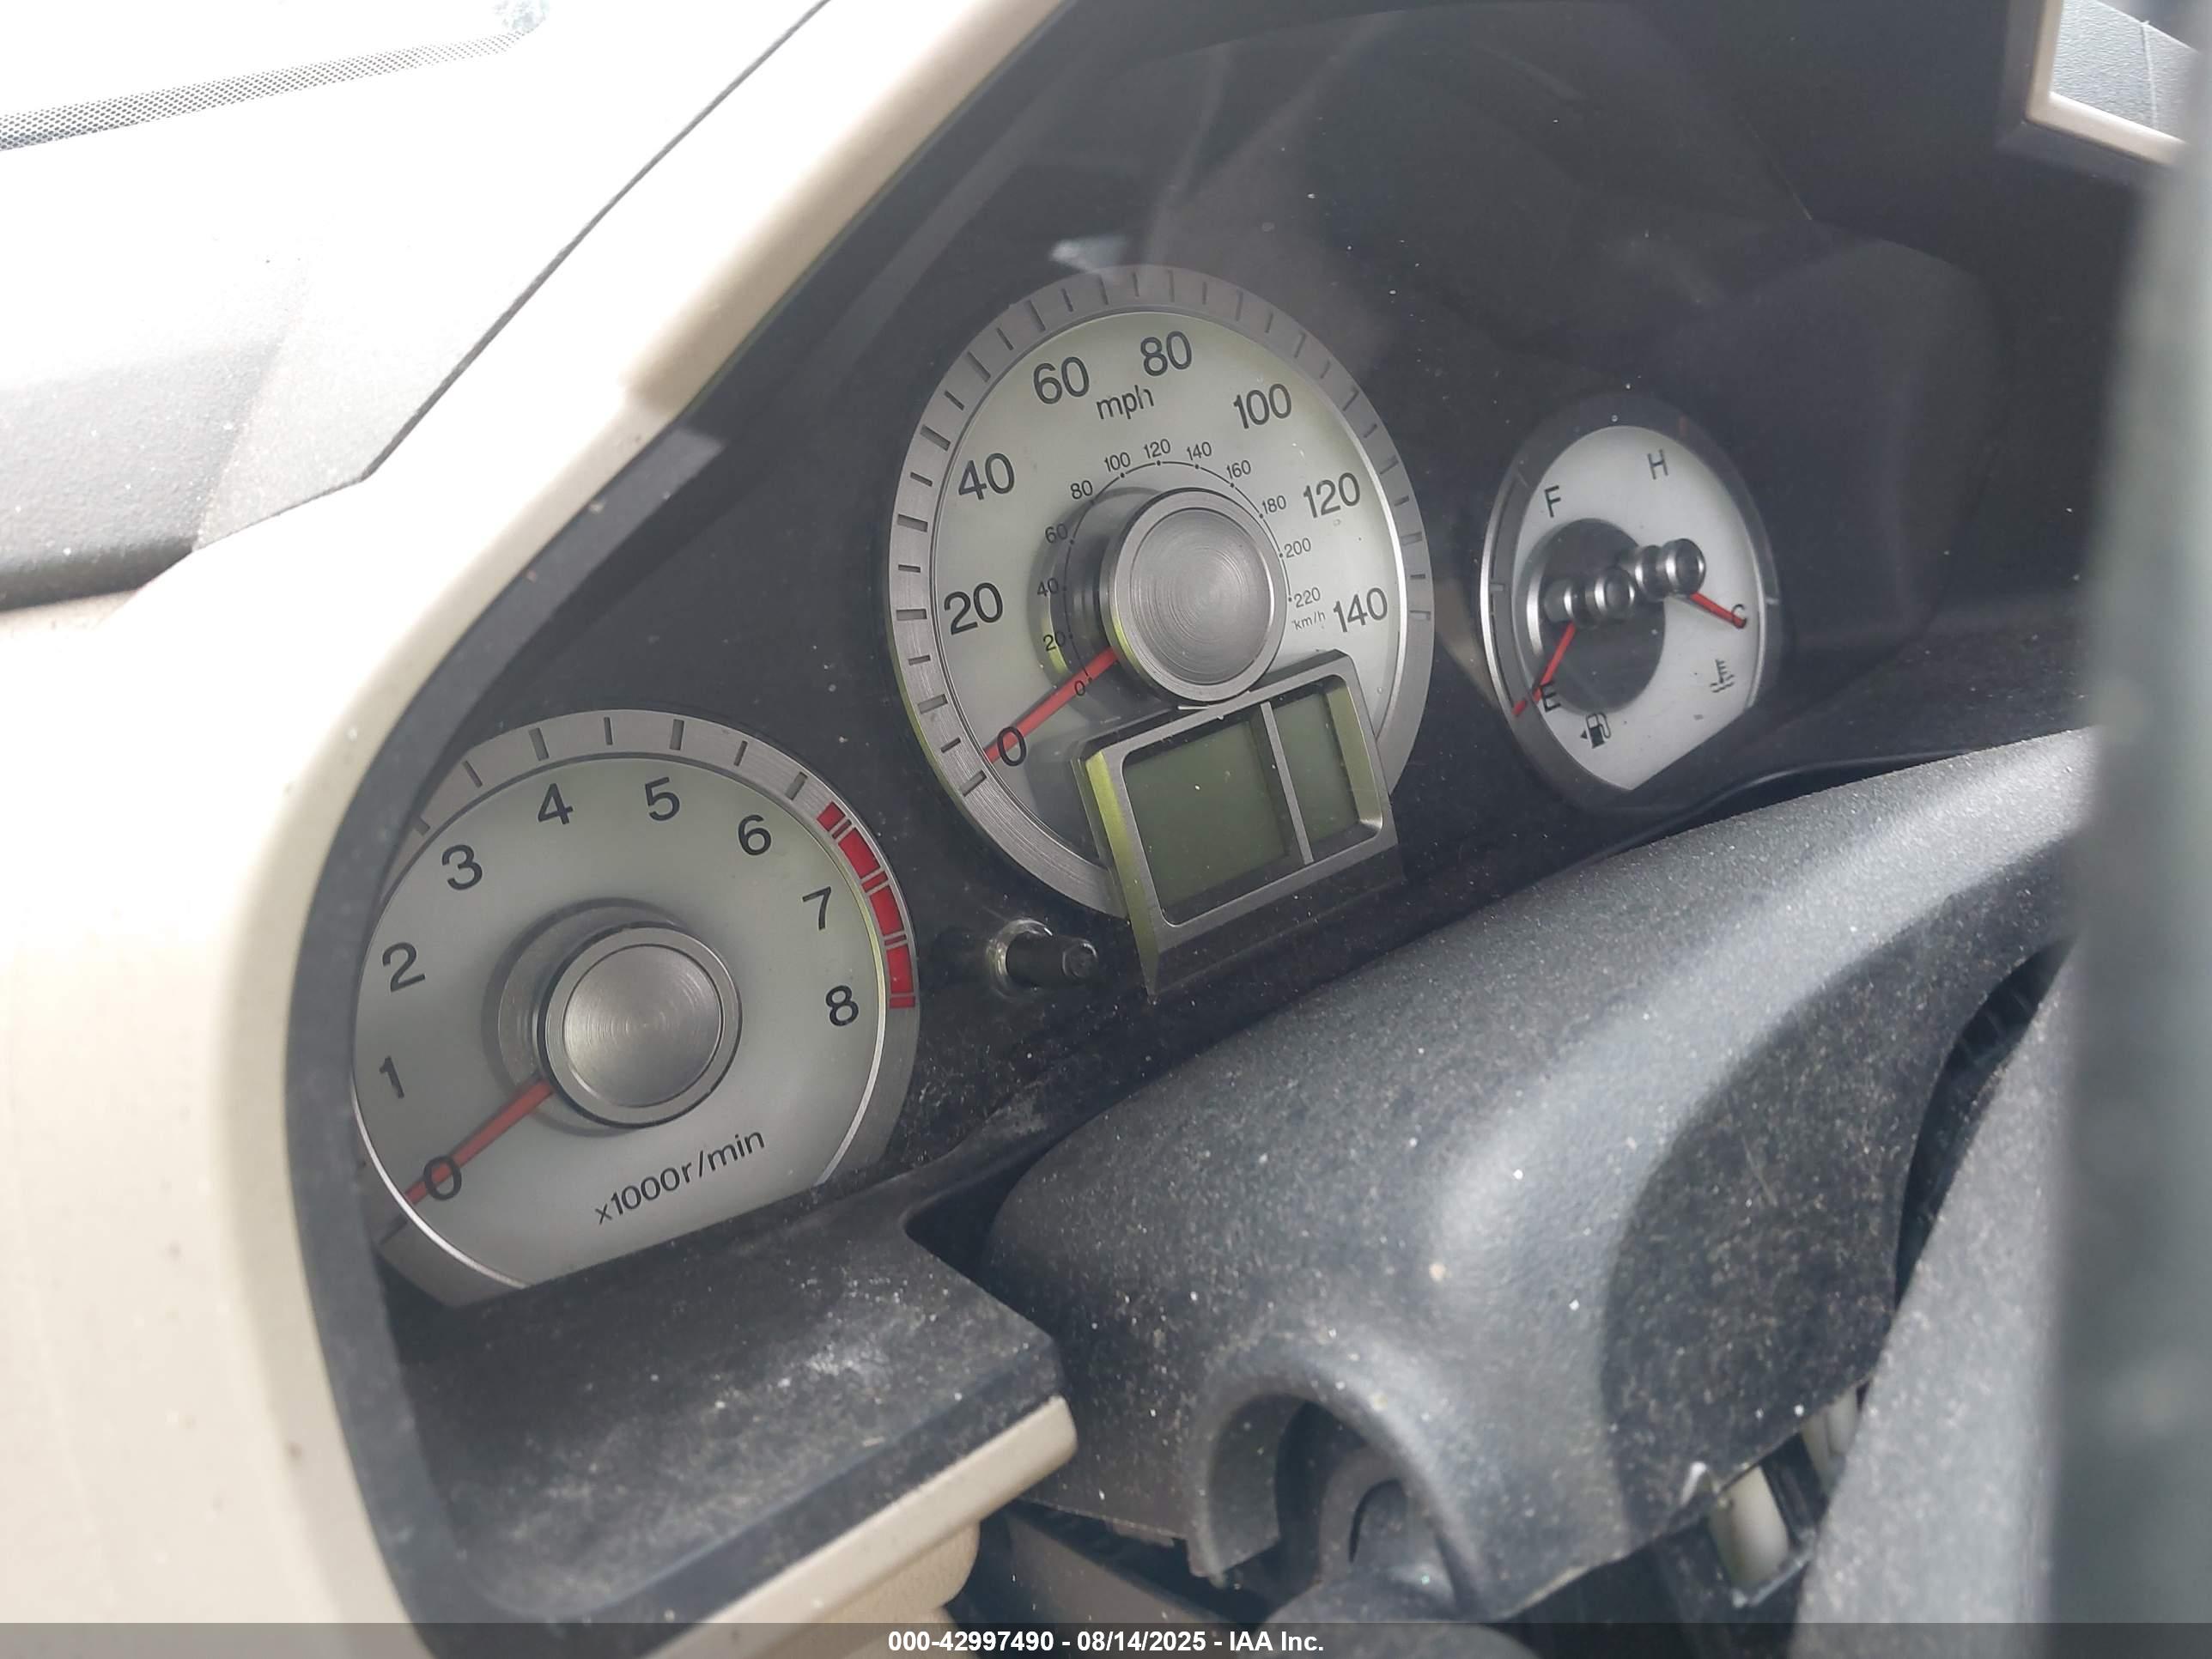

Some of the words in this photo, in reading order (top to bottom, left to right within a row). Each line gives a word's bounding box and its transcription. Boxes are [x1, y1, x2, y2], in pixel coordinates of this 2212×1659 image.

[1139, 331, 1192, 377] 80
[1033, 356, 1090, 404] 60
[1096, 384, 1155, 421] mph
[1233, 383, 1292, 429] 100
[1103, 453, 1131, 472] 100
[1143, 438, 1172, 459] 120
[1186, 441, 1213, 461] 140
[1647, 449, 1668, 480] H
[957, 453, 1015, 501] 40
[1225, 459, 1252, 480] 160
[1070, 479, 1094, 501] 80
[1261, 495, 1287, 515] 180
[1303, 472, 1361, 519] 120
[1544, 485, 1561, 517] F
[1044, 523, 1068, 544] 60
[1284, 538, 1312, 559] 200
[1036, 577, 1060, 598] 40
[1294, 586, 1322, 608] 220
[944, 582, 1004, 635] 20
[1291, 611, 1327, 631] km/h
[1333, 586, 1389, 633] 140
[1730, 603, 1747, 629] C
[1042, 630, 1066, 652] 20
[1073, 679, 1087, 697] 0
[1541, 682, 1561, 713] E
[996, 726, 1027, 767] 0
[536, 782, 574, 826] 4
[644, 777, 681, 821] 5
[737, 814, 773, 856] 6
[441, 844, 483, 890] 3
[802, 886, 834, 931] 7
[381, 942, 427, 992] 2
[824, 985, 860, 1028] 8
[378, 1054, 405, 1099] 1
[422, 1156, 462, 1201] 0
[593, 1129, 766, 1225] x1000r/min
